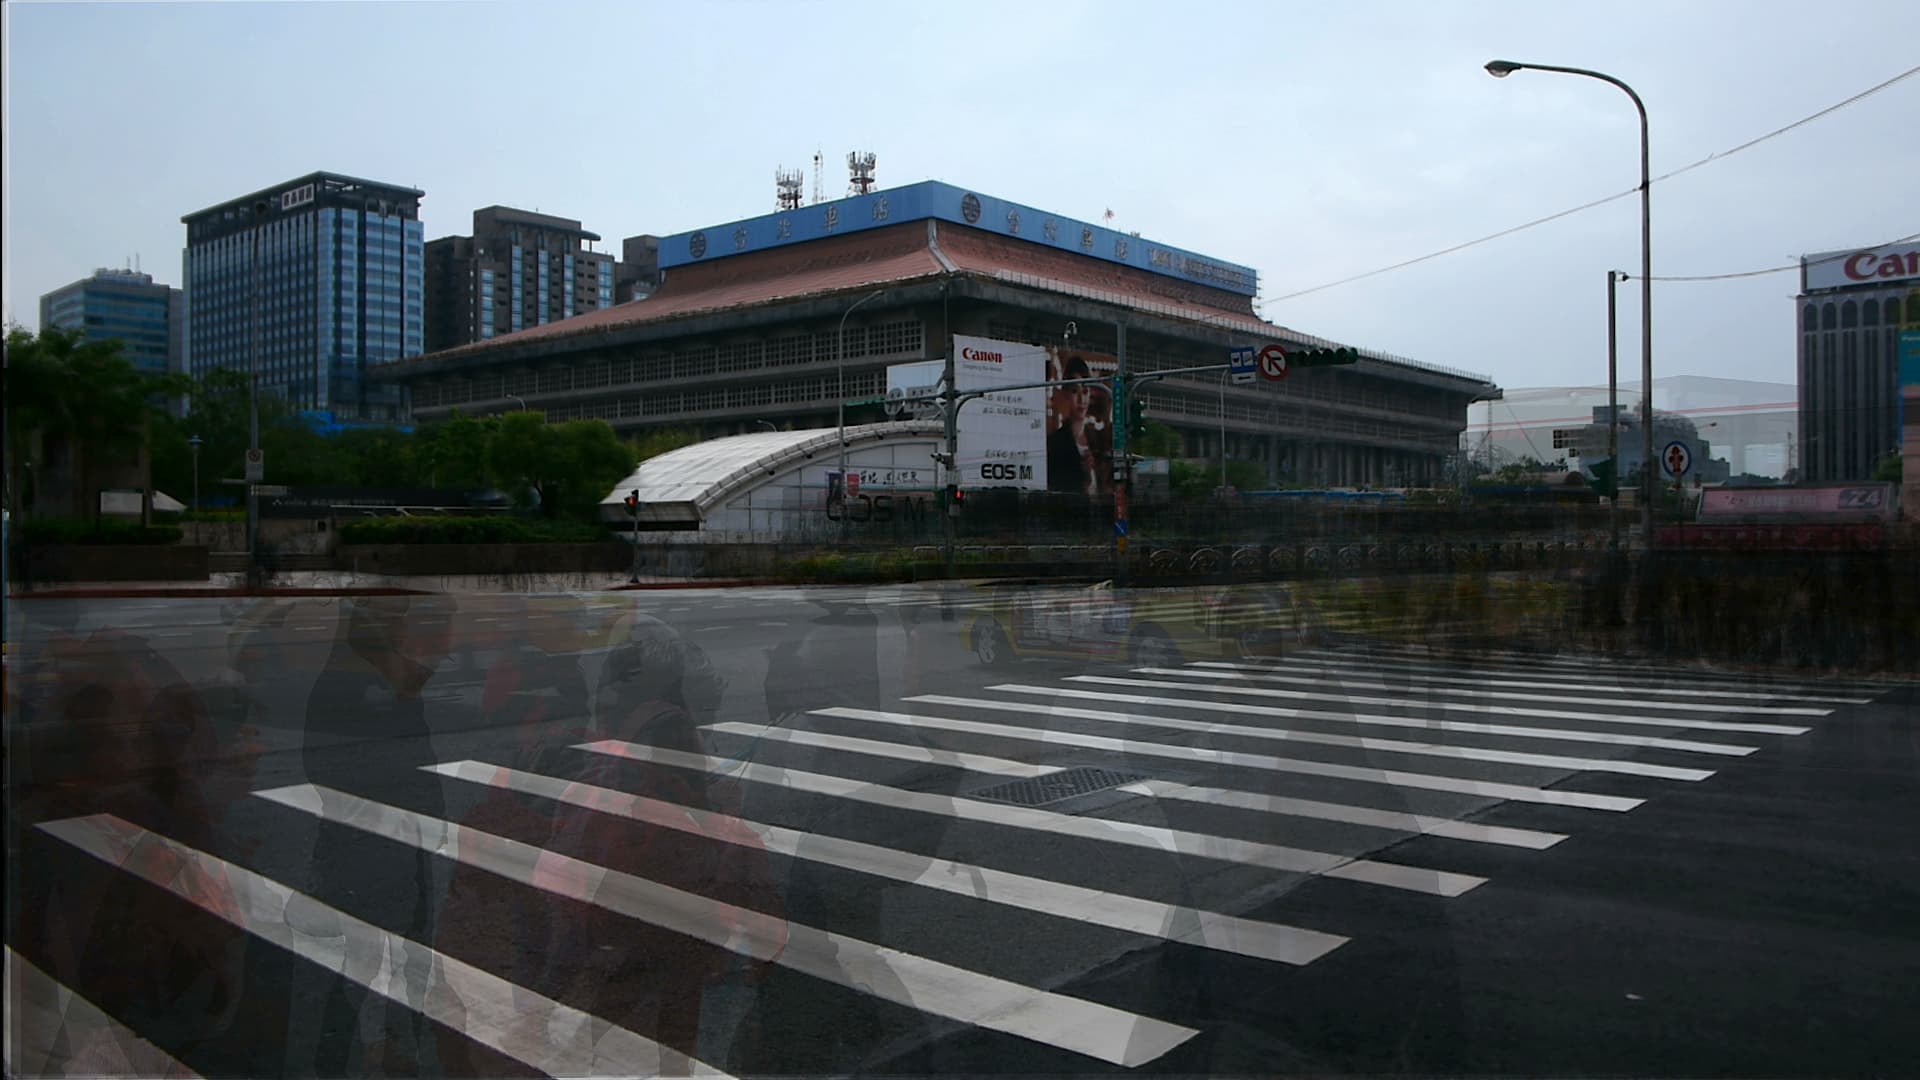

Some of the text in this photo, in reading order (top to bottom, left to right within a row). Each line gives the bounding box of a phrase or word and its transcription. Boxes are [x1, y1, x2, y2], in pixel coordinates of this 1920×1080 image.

[962, 347, 1003, 364] Canon
[981, 463, 1033, 480] EOS M
